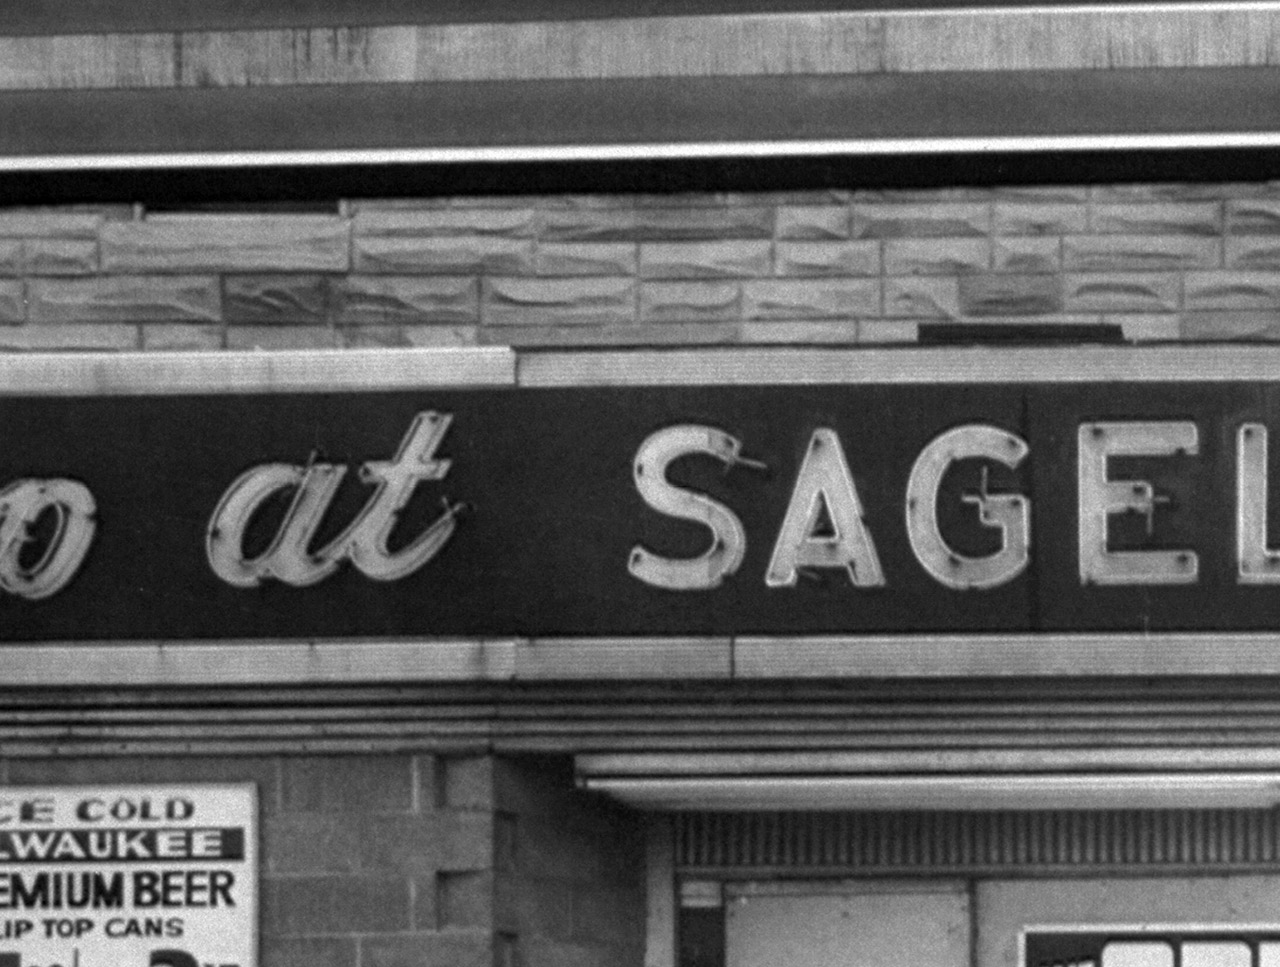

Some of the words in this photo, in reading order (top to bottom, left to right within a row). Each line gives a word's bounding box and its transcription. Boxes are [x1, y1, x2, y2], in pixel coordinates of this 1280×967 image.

[206, 410, 462, 587] at
[76, 799, 195, 822] COLD
[132, 870, 236, 909] BEER
[0, 919, 34, 939] IP
[42, 918, 94, 939] TOP
[105, 917, 185, 939] CANS
